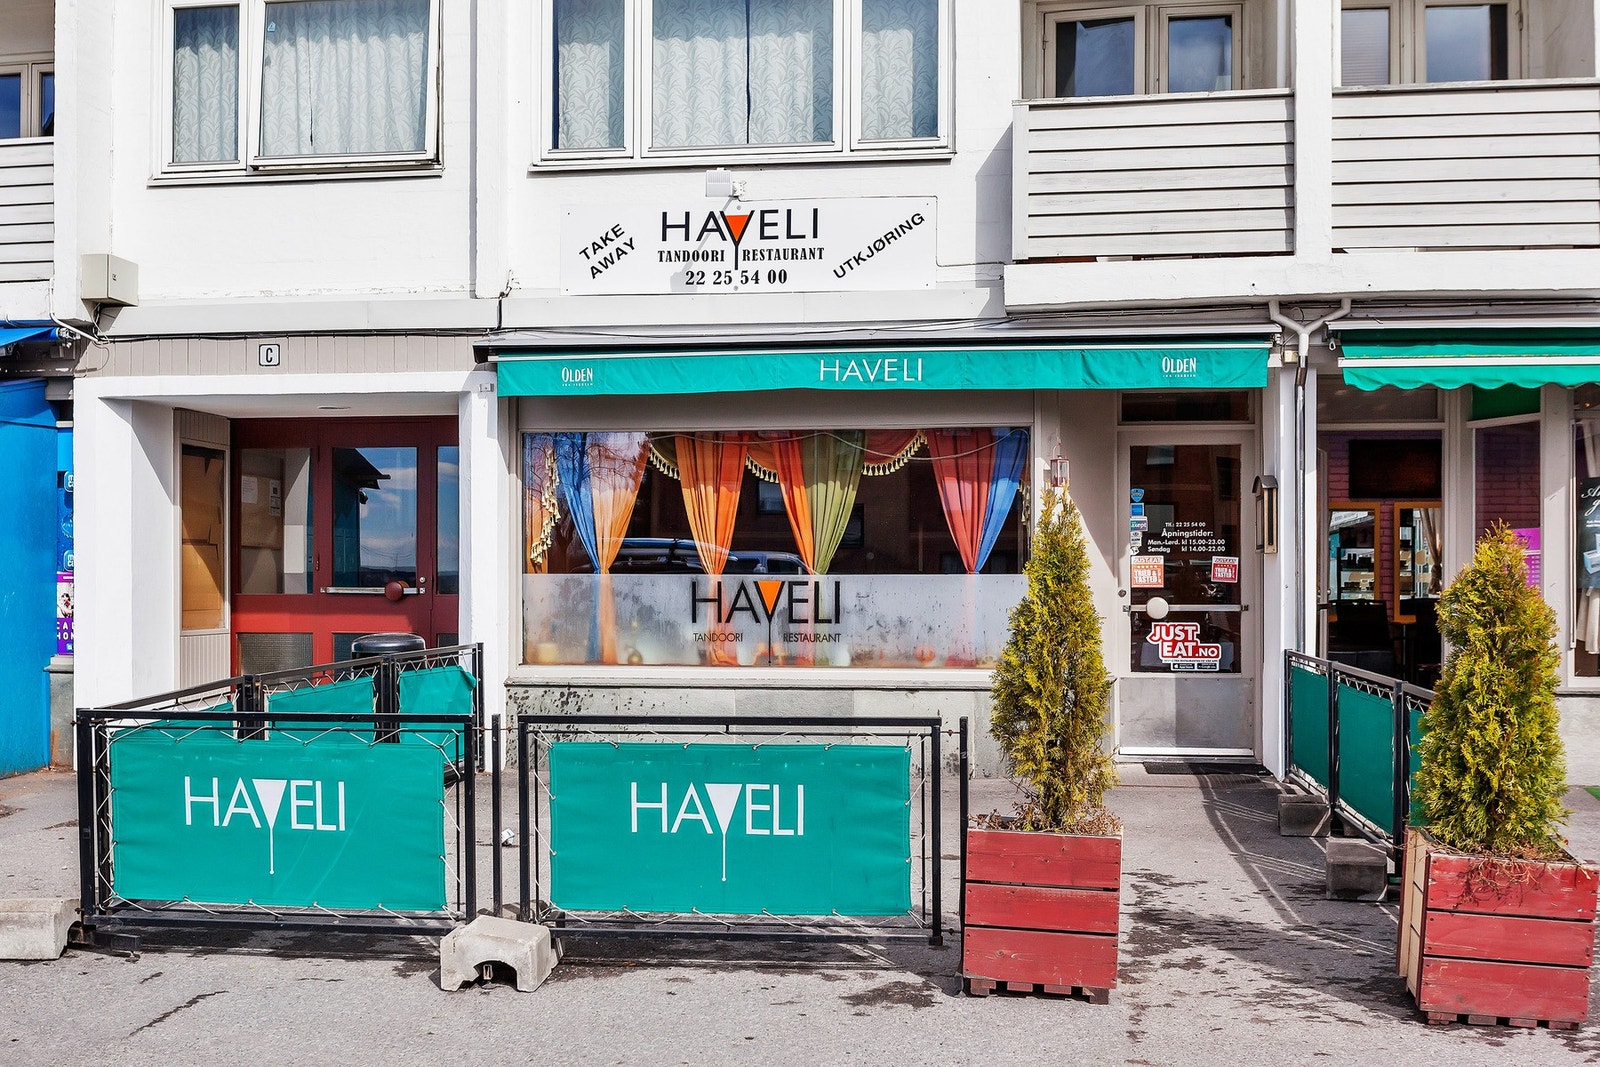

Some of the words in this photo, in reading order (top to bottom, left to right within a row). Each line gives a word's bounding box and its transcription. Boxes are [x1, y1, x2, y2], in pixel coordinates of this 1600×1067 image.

[661, 207, 819, 242] HAVELI
[579, 223, 625, 260] TAKE
[832, 212, 925, 278] UTKJØRING
[589, 237, 635, 279] AWAY
[657, 249, 725, 263] TANDOORI
[742, 247, 825, 262] RESTAURANT
[685, 270, 706, 286] 22
[712, 270, 733, 285] 25
[740, 269, 760, 285] 54
[767, 269, 788, 284] 00
[266, 347, 273, 363] C
[819, 357, 922, 382] HAVELI
[1161, 528, 1213, 538] Åpningstider:
[691, 580, 840, 624] HAVELI
[693, 632, 744, 642] TANDOORI
[783, 632, 842, 643] RESTAURANT
[1151, 625, 1197, 640] JUST
[1162, 642, 1218, 657] EAT.NO
[184, 776, 345, 875] HAVELI
[631, 781, 804, 882] HAVELI
